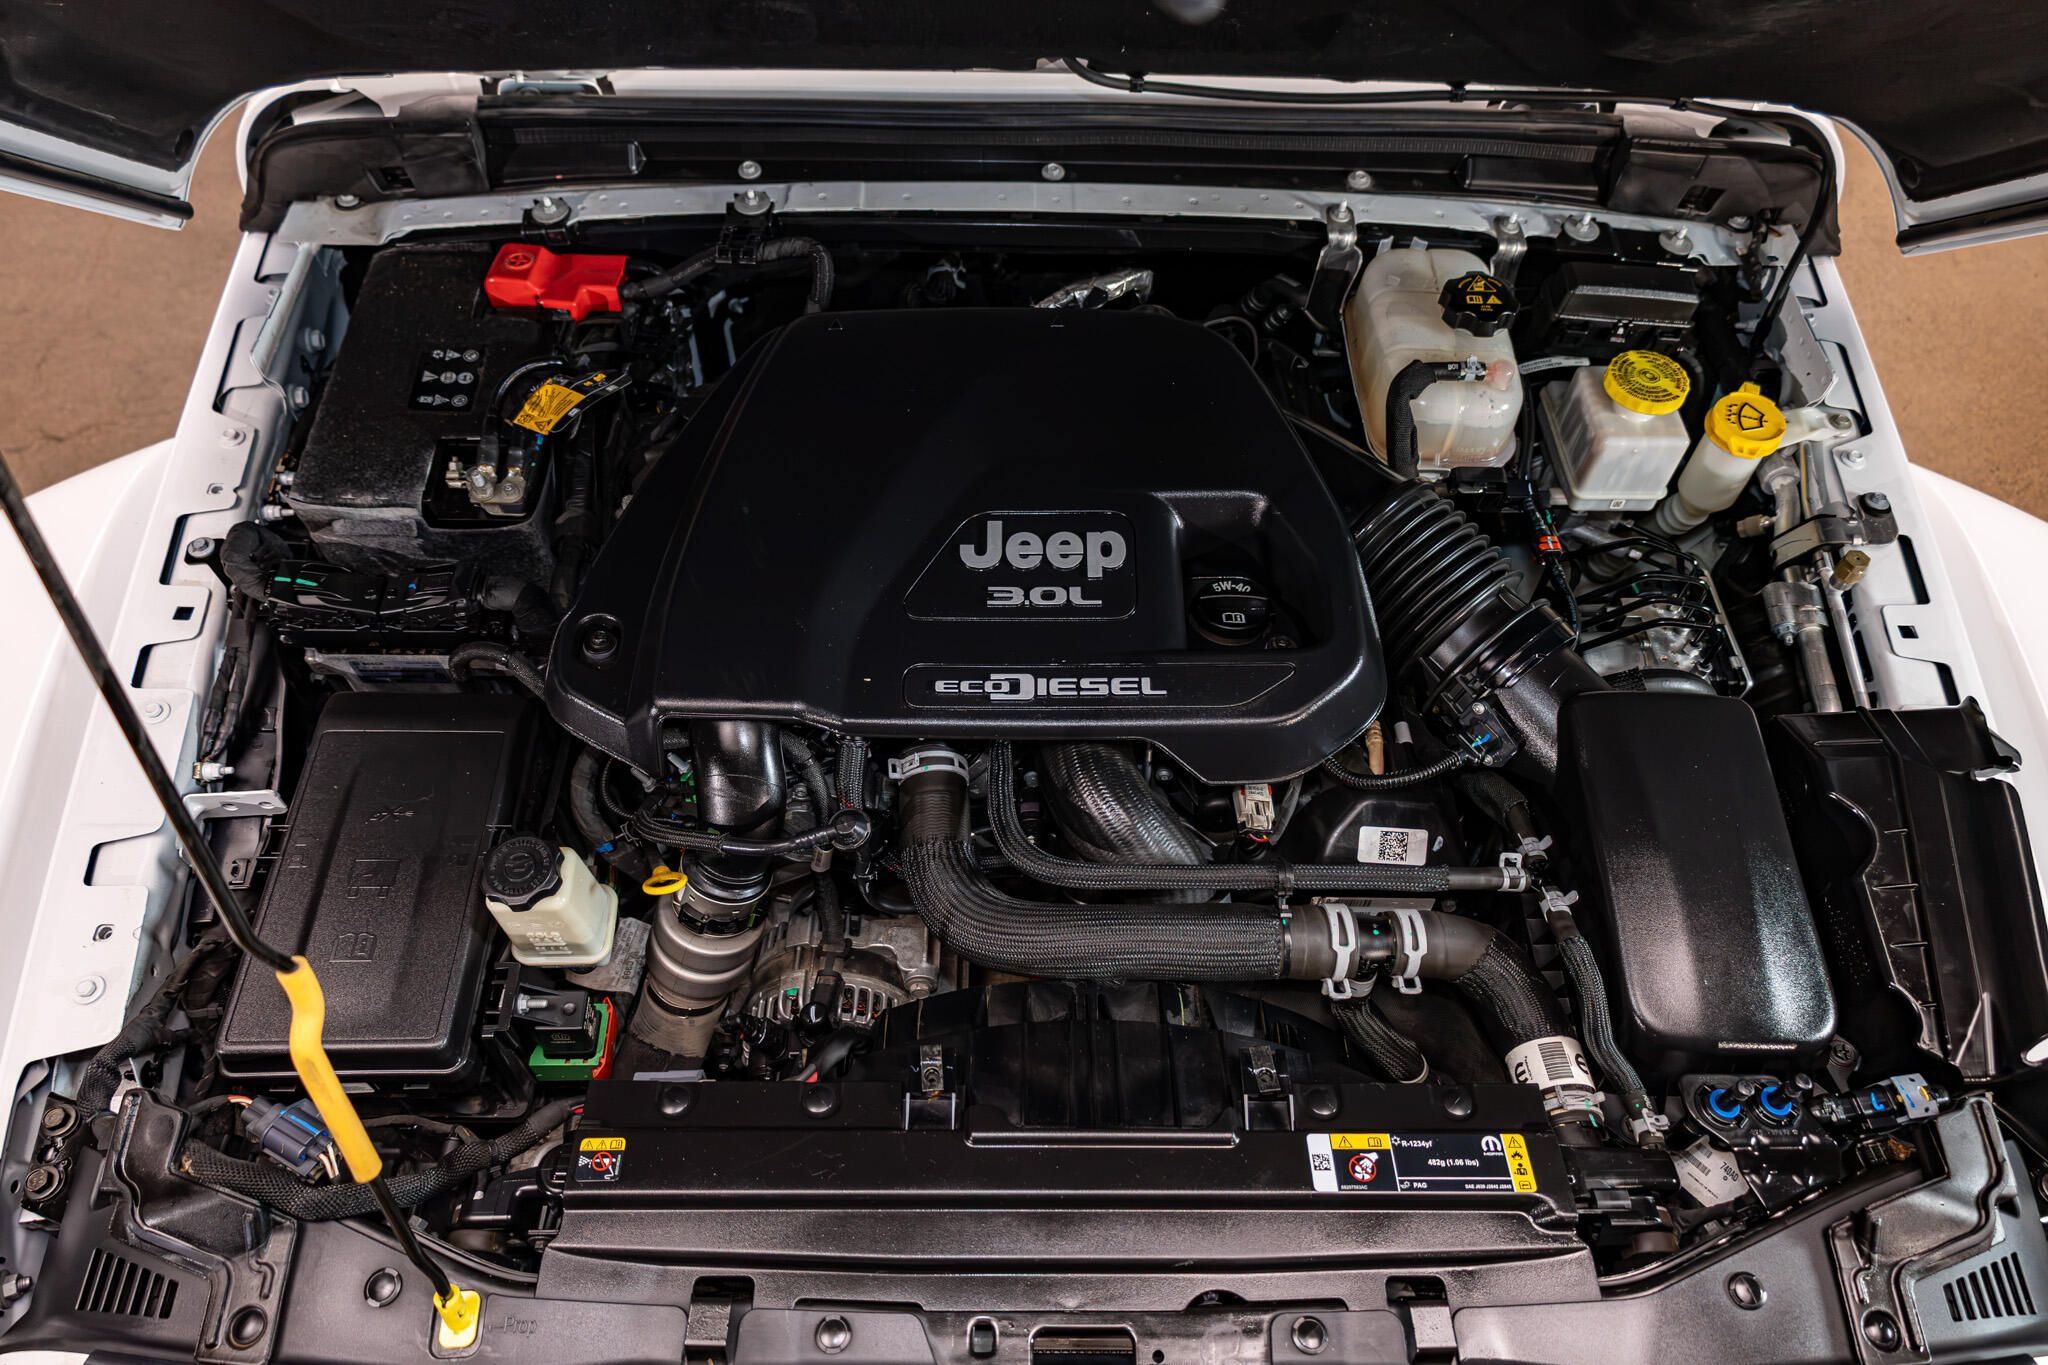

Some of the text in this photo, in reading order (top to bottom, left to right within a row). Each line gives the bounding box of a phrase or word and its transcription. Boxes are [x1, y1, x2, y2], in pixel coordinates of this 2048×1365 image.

[959, 520, 1127, 580] Jeep
[1212, 580, 1251, 593] 5W-40
[986, 586, 1103, 607] 3.0L
[1401, 1140, 1433, 1148] R-1234yf
[1465, 1159, 1480, 1167] lbs)
[503, 1316, 538, 1338] Prop
